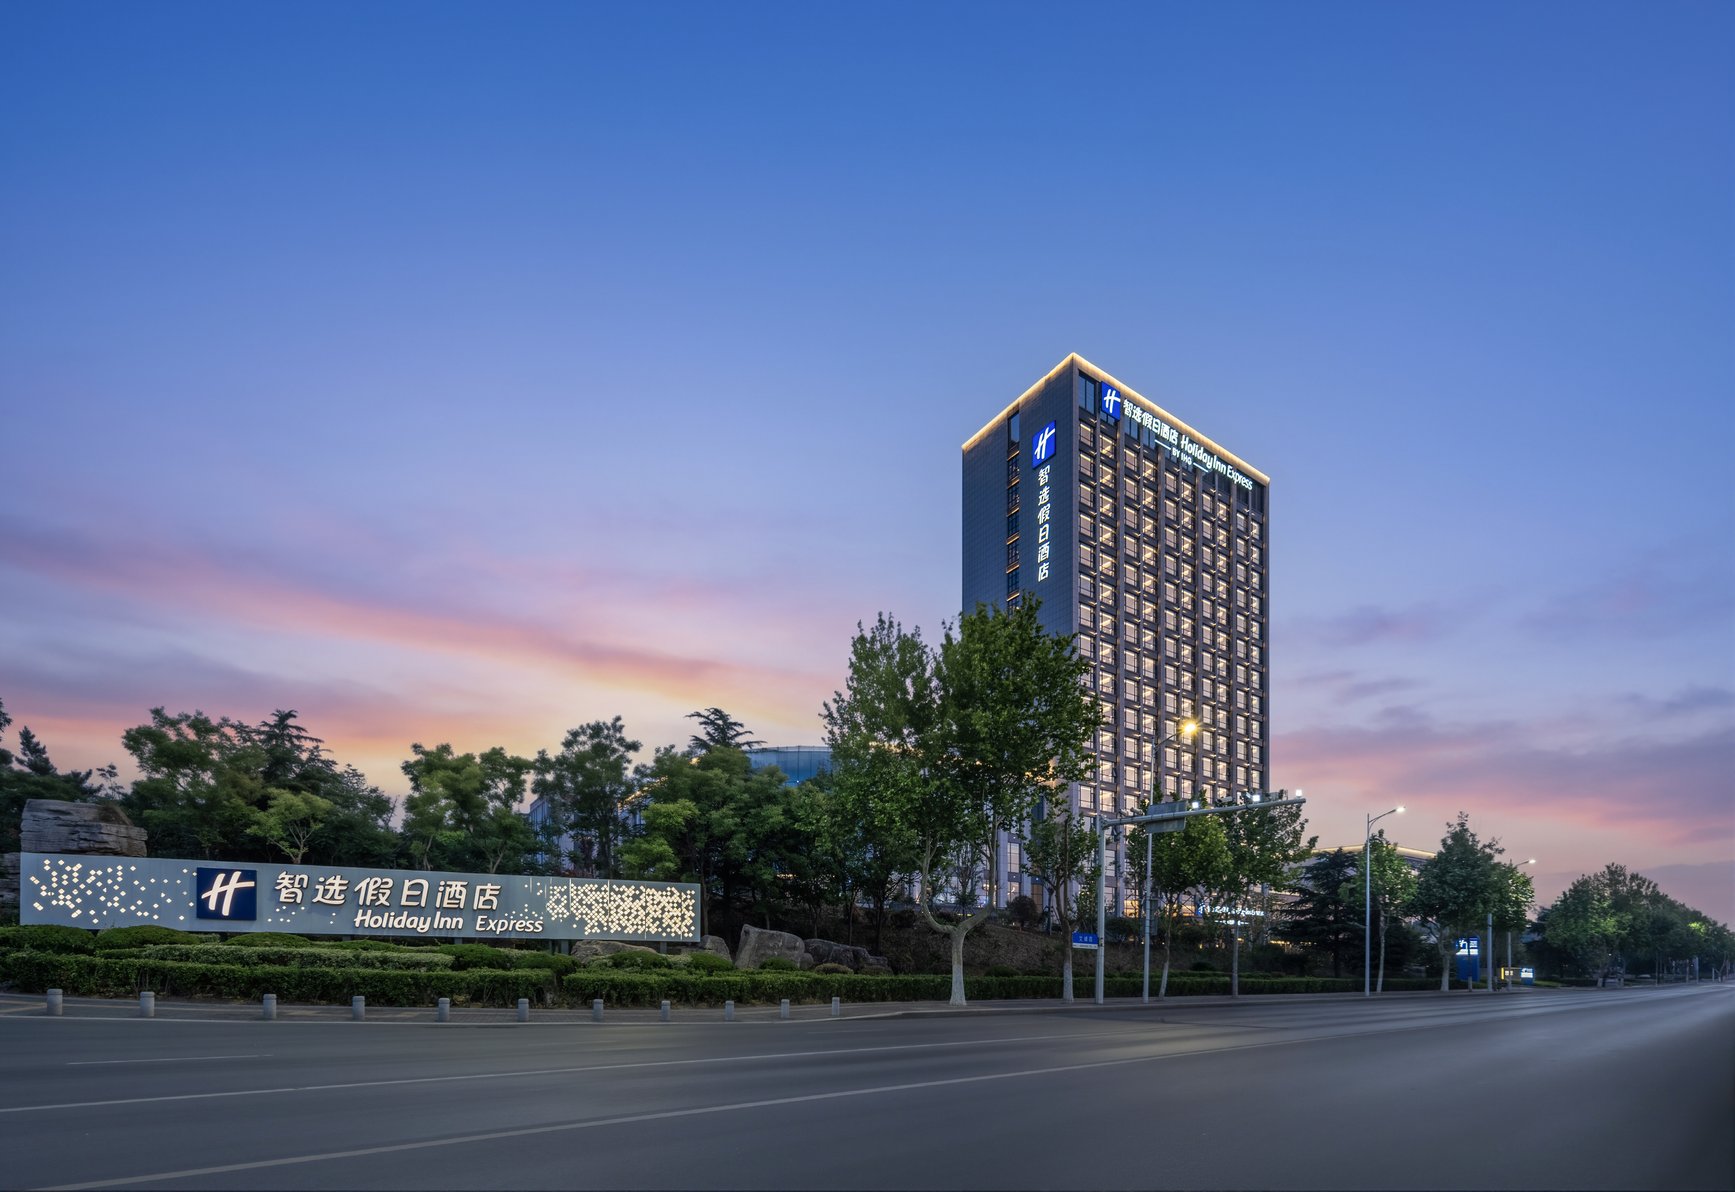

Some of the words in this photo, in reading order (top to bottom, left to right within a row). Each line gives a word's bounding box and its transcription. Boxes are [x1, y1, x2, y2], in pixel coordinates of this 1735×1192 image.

[1123, 398, 1179, 446] 智选假日酒店
[1172, 448, 1180, 459] BY
[1180, 453, 1192, 465] IHG
[1227, 465, 1253, 490] Express
[1037, 464, 1051, 582] 智选假日酒店
[275, 870, 501, 911] 智选假日酒店
[475, 915, 544, 934] Express
